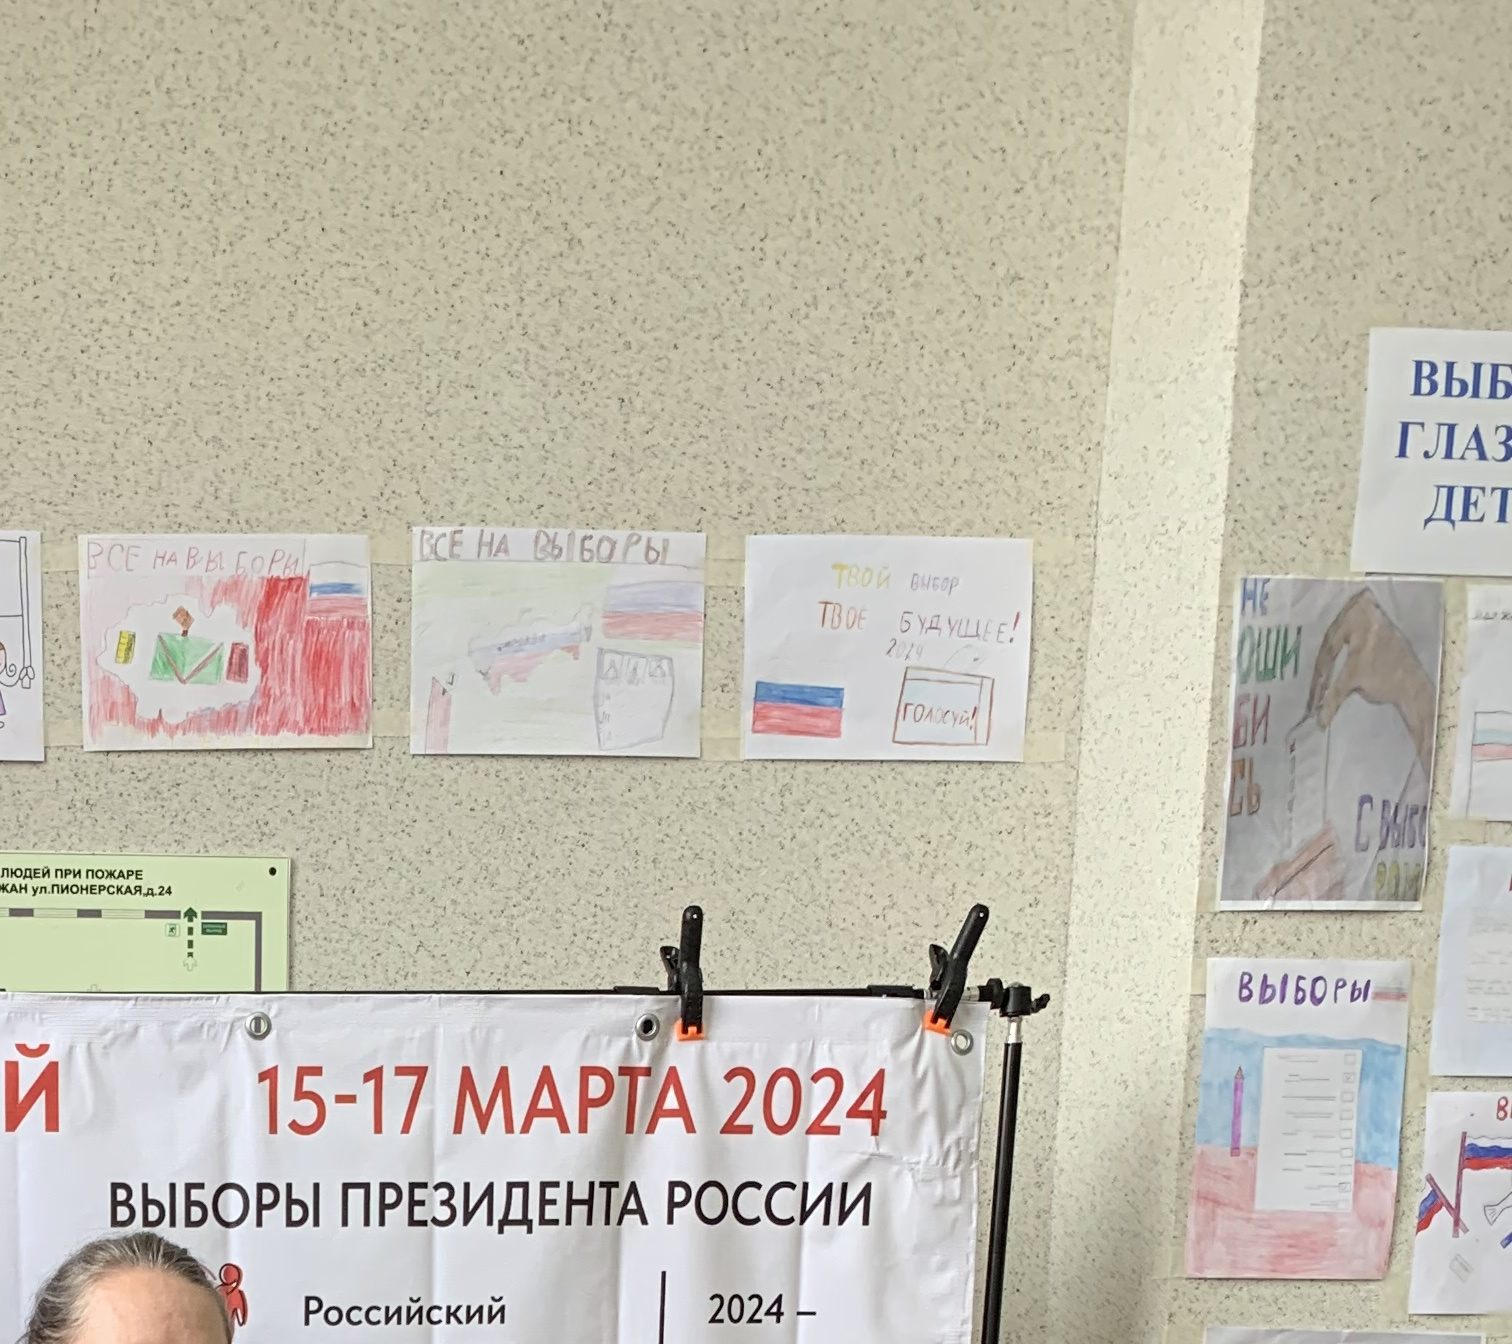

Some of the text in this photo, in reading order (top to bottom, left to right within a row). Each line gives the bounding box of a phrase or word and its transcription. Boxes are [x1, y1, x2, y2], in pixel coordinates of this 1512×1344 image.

[88, 541, 141, 572] ВСЕ
[153, 549, 178, 570] НА
[420, 529, 670, 565] ВСЕ НА ВЫБОРЫ
[832, 563, 891, 588] ТВОЙ
[1241, 578, 1271, 616] НЕ
[818, 601, 1020, 643] ТВОЕ БУДУЩЕЕ!
[886, 638, 924, 661] 2024
[0, 865, 51, 880] ЛЮДЕЙ
[54, 868, 82, 879] ПРИ
[85, 868, 143, 880] ПОЖАРЕ
[1238, 971, 1371, 1006] ВЫБОРЫ
[257, 1064, 887, 1136] 15-17 МАРТА 2024
[110, 1180, 872, 1234] ВЫБОРЫ ПРЕЗИДЕНТА РОССИИ
[304, 1296, 506, 1326] Российский
[708, 1293, 785, 1324] 2024
